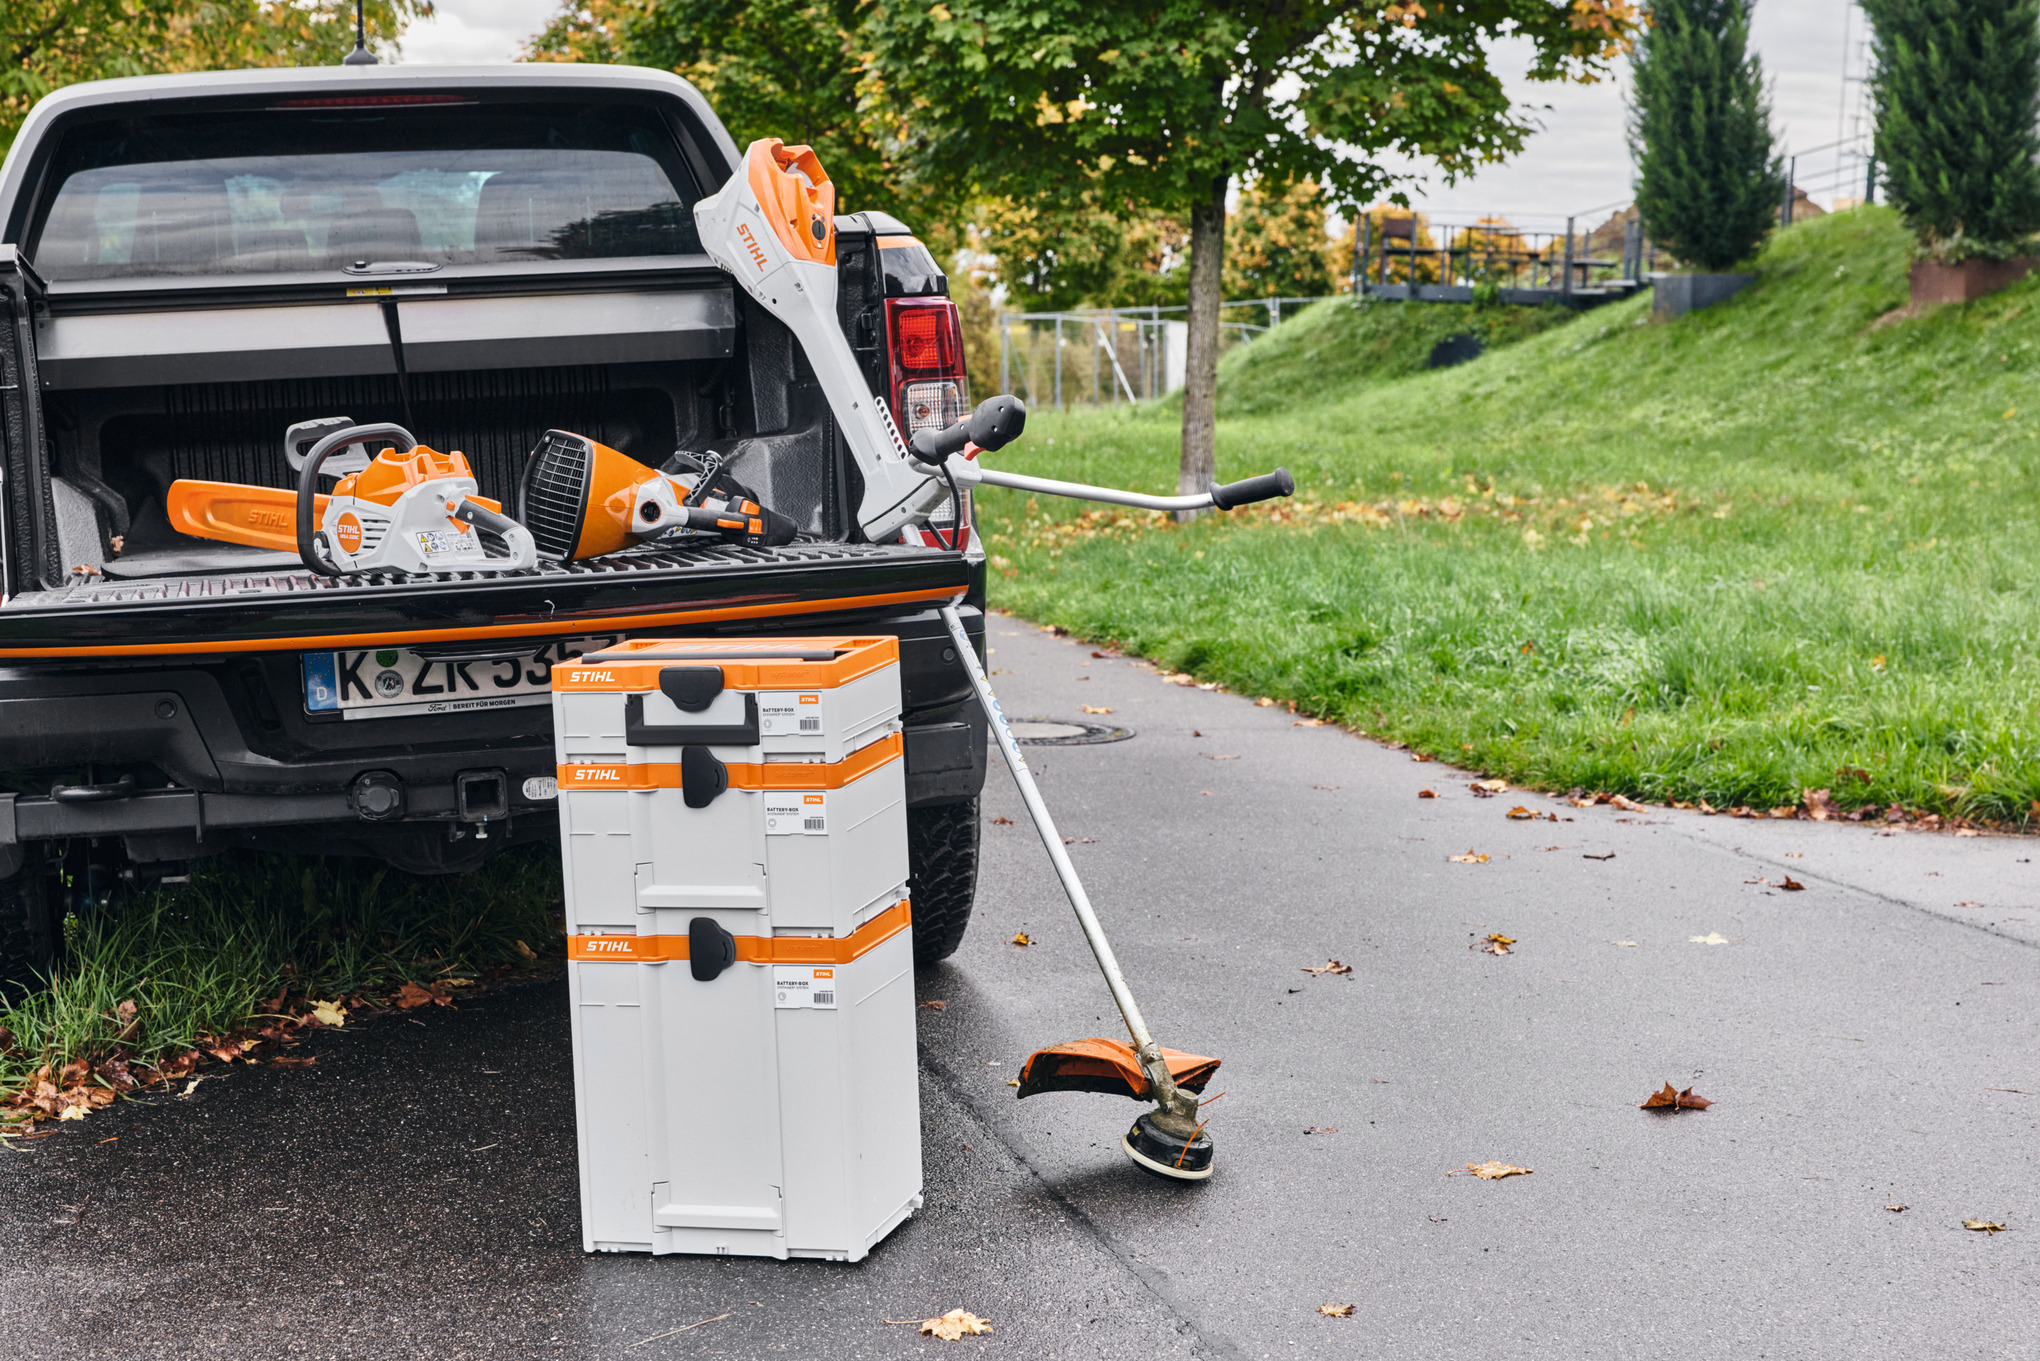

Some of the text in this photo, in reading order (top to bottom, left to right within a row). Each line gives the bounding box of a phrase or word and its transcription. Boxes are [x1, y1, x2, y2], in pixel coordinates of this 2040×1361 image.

[736, 223, 768, 272] STIHL
[248, 509, 289, 528] STIHL
[337, 524, 360, 535] STIHL
[338, 652, 374, 701] K
[569, 671, 616, 682] STIHL
[316, 686, 328, 701] D
[428, 699, 516, 712] Ford BEREIT FÜR MORGEN
[574, 769, 621, 781] STIHL
[586, 941, 633, 952] STIHL
